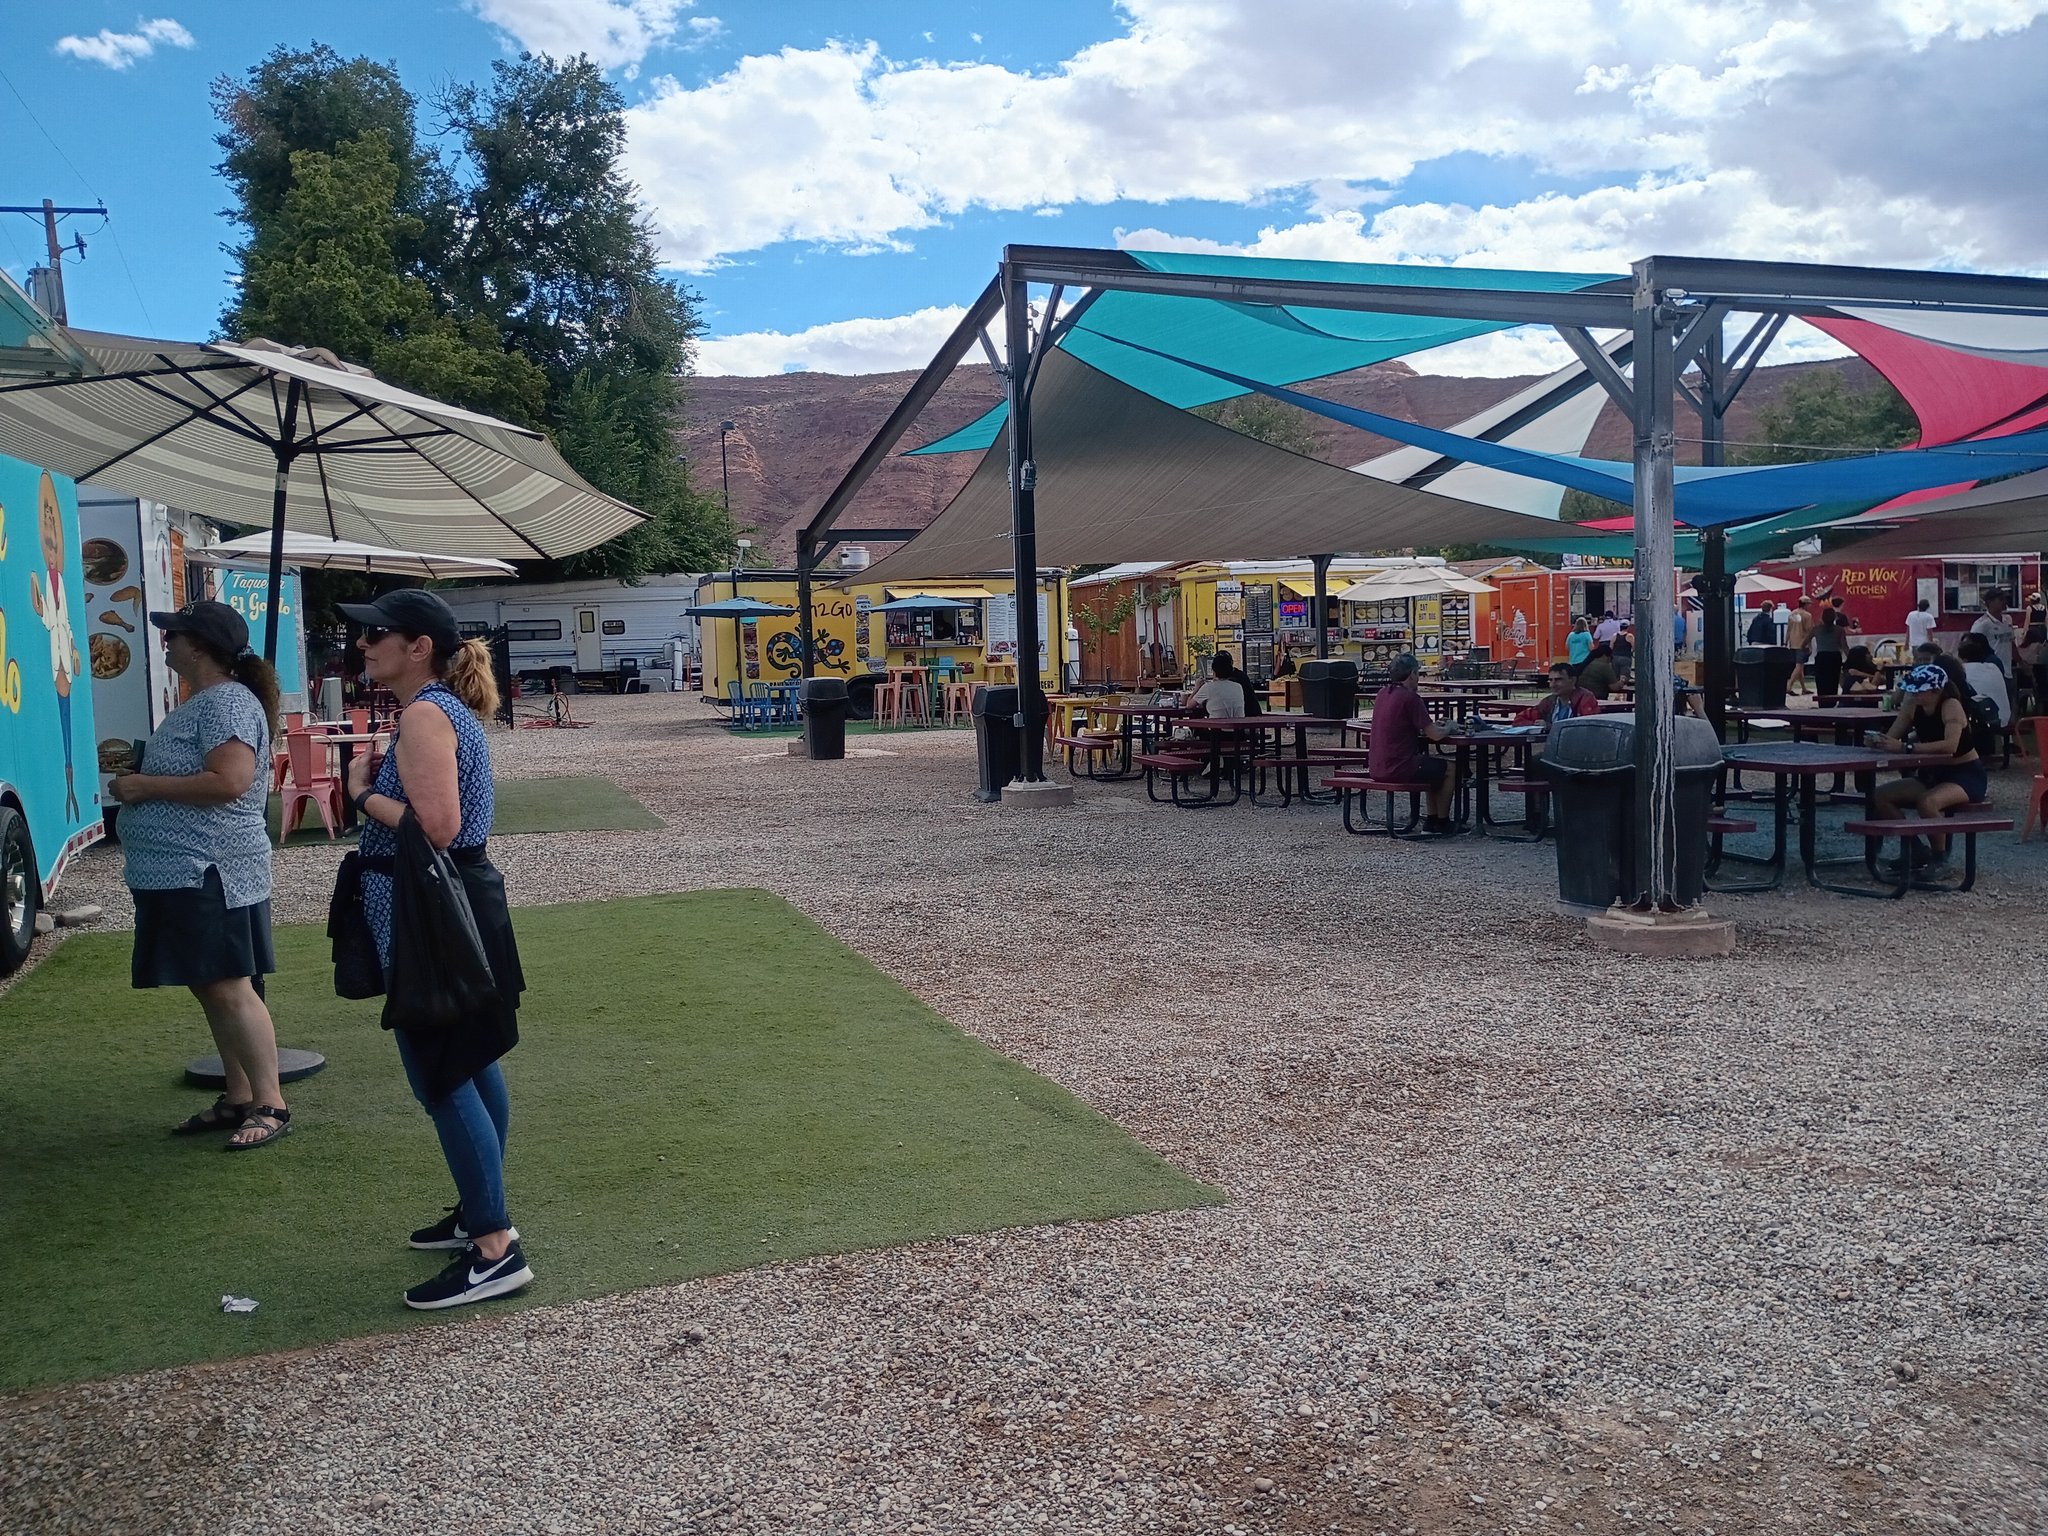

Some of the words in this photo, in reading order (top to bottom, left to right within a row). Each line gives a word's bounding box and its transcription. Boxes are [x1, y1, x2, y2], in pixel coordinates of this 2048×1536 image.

[1841, 568, 1866, 585] RED
[1869, 567, 1899, 583] WOK
[1846, 585, 1888, 595] KITCHEN
[1282, 604, 1305, 614] OPEN
